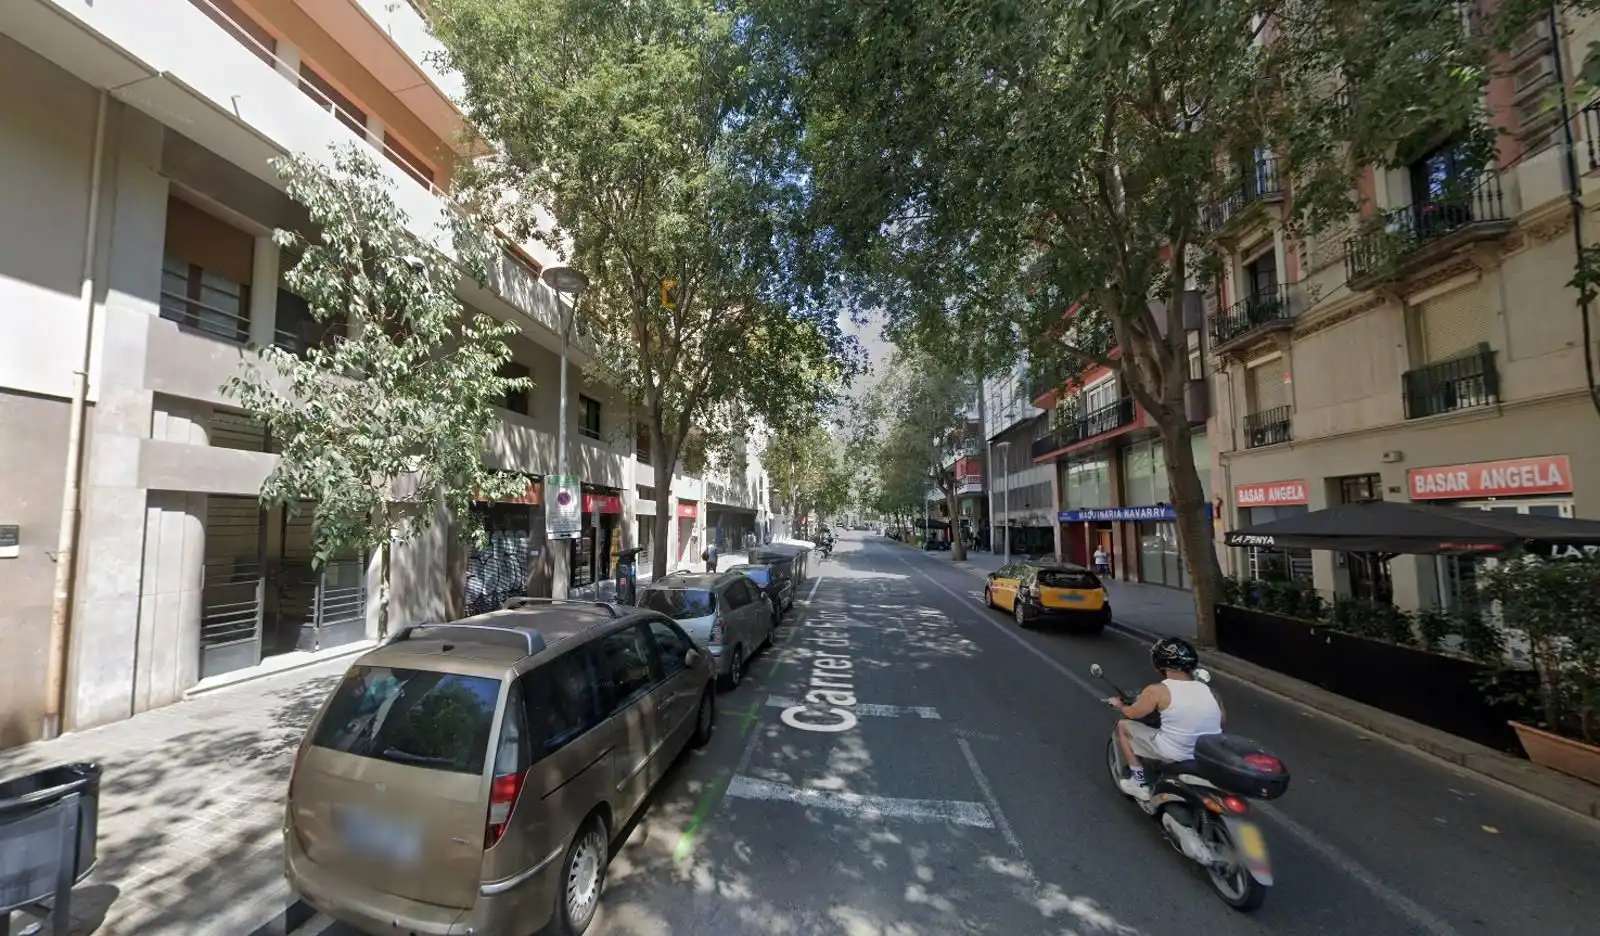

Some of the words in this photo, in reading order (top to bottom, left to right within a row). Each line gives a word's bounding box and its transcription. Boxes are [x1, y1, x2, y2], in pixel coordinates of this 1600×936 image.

[1415, 471, 1470, 493] BASAR
[1480, 463, 1564, 490] ANGELA
[1239, 488, 1265, 503] BASAR
[1268, 485, 1305, 501] ANGELA
[1078, 509, 1122, 520] MAQUINARIA
[1123, 507, 1166, 518] NAVARRY
[1231, 535, 1242, 543] LA
[1243, 535, 1275, 545] PENYA
[1551, 544, 1583, 559] LA
